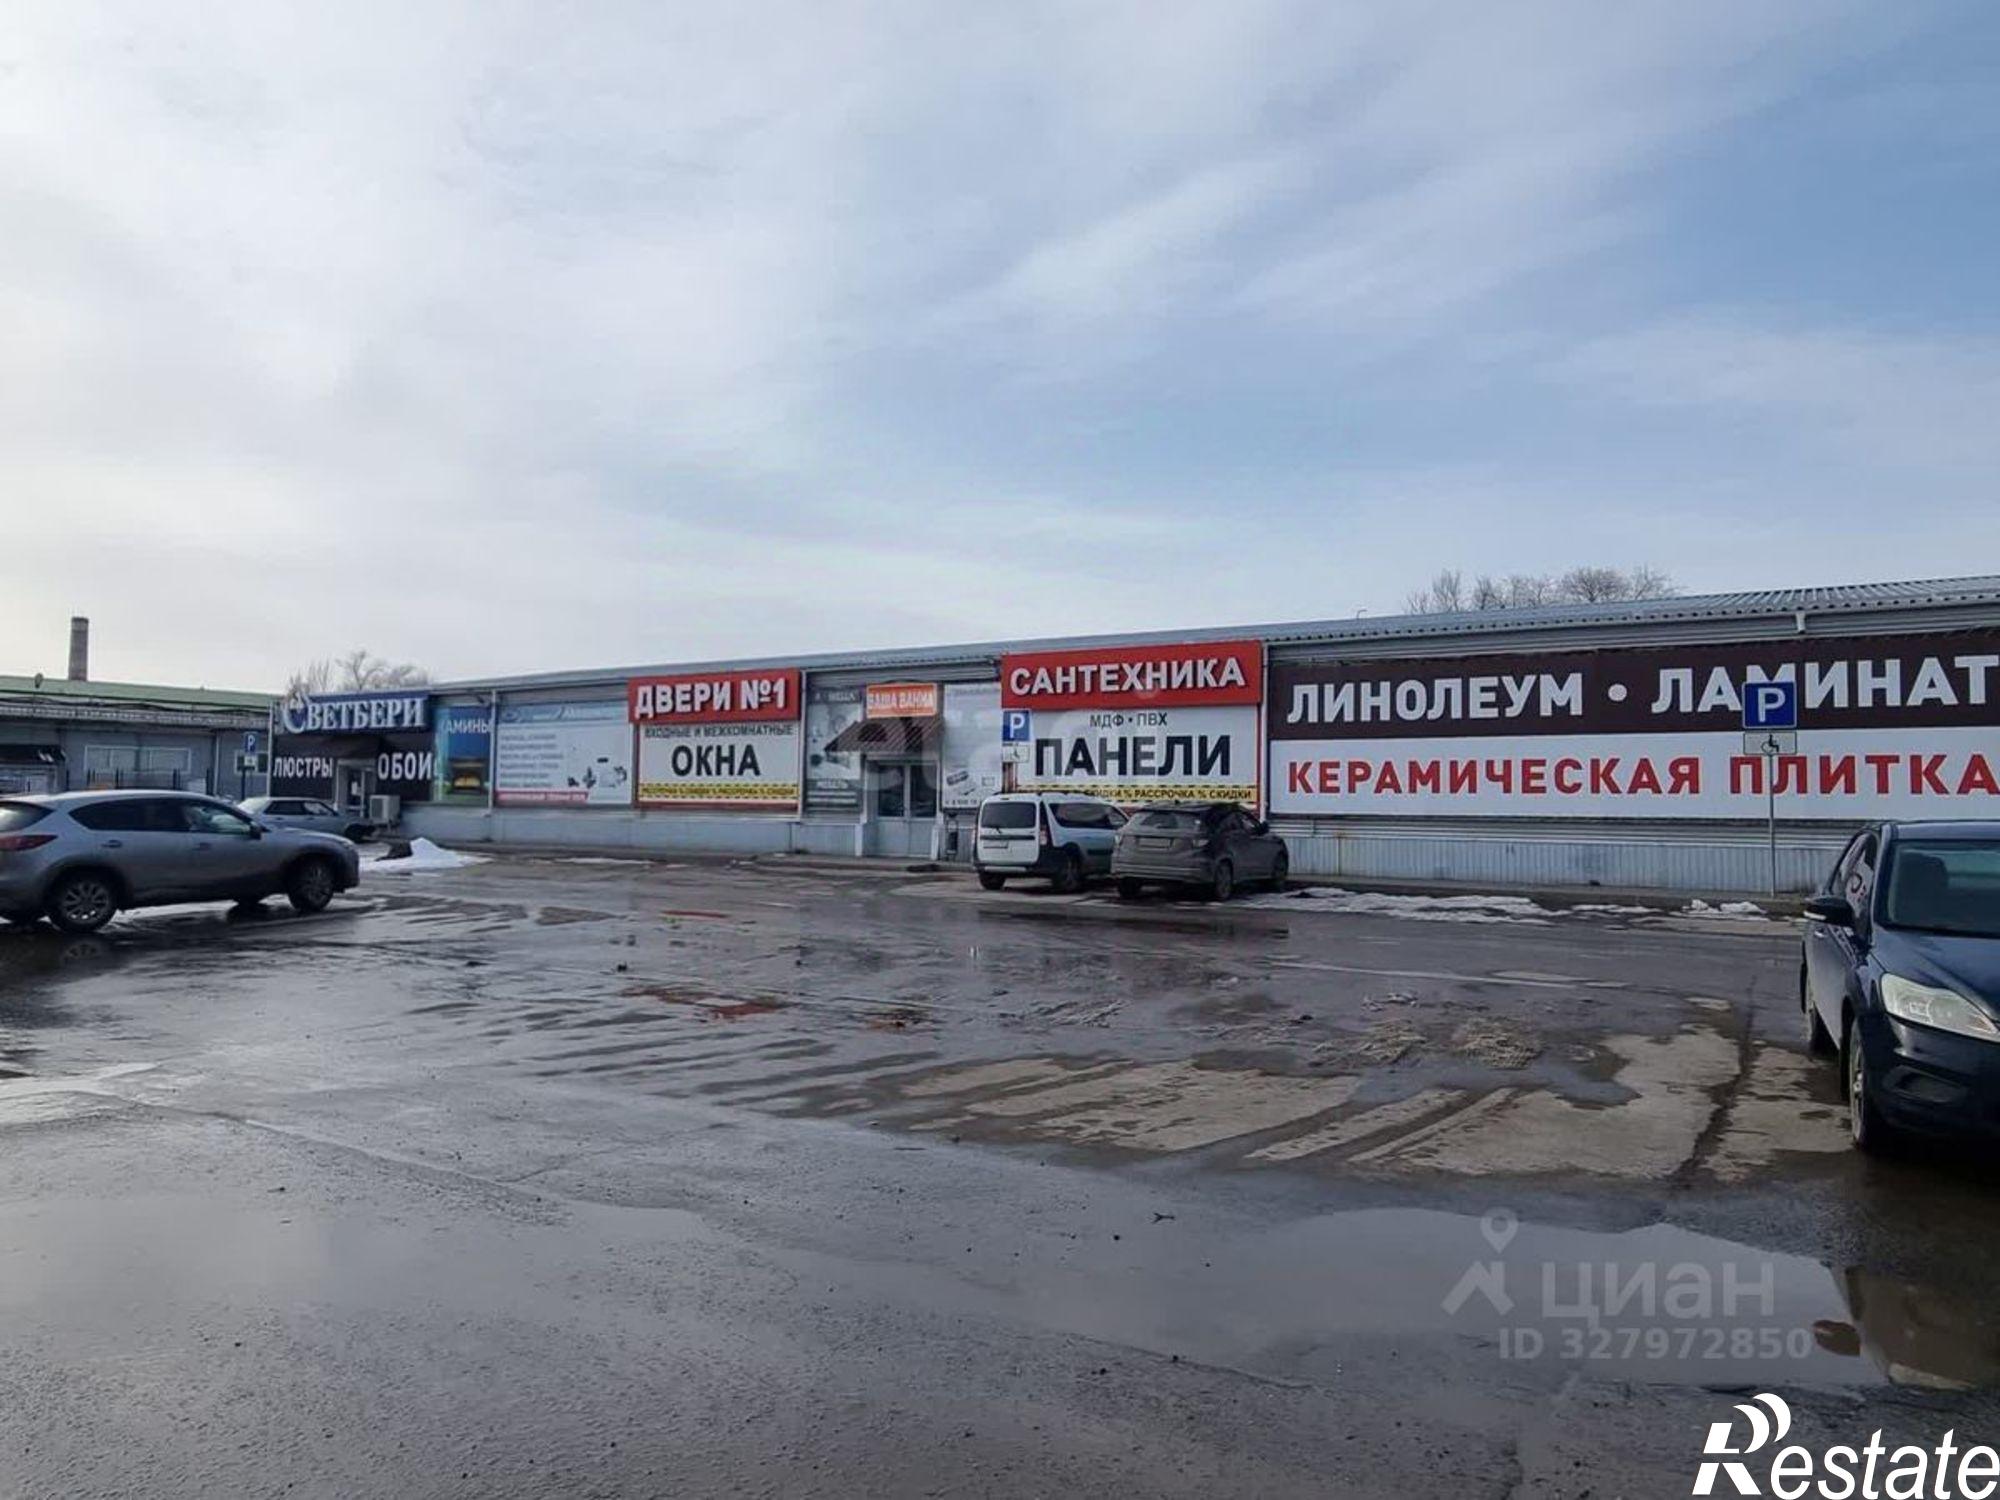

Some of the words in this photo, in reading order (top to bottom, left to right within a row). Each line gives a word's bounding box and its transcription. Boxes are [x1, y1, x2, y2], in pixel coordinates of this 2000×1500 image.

[1010, 656, 1246, 697] САНТЕХНИКА
[634, 681, 731, 719] ДВЕРИ
[1287, 672, 1584, 724] ЛИНОЛЕУМ
[1758, 687, 1787, 722] P
[1009, 713, 1025, 738] P
[1089, 714, 1124, 728] МДФ
[1137, 712, 1167, 726] ПВХ
[273, 756, 333, 780] ЛЮСТРЫ
[377, 751, 432, 781] ОБОИ
[671, 744, 760, 777] ОКНА
[1035, 735, 1231, 777] ПАНЕЛИ
[1287, 756, 1701, 795] КЕРАМИЧЕСКАЯ
[1729, 754, 2000, 795] ПЛИТКА
[1134, 789, 1195, 799] РАССРОЧКА
[1209, 789, 1252, 799] СКИДКИ
